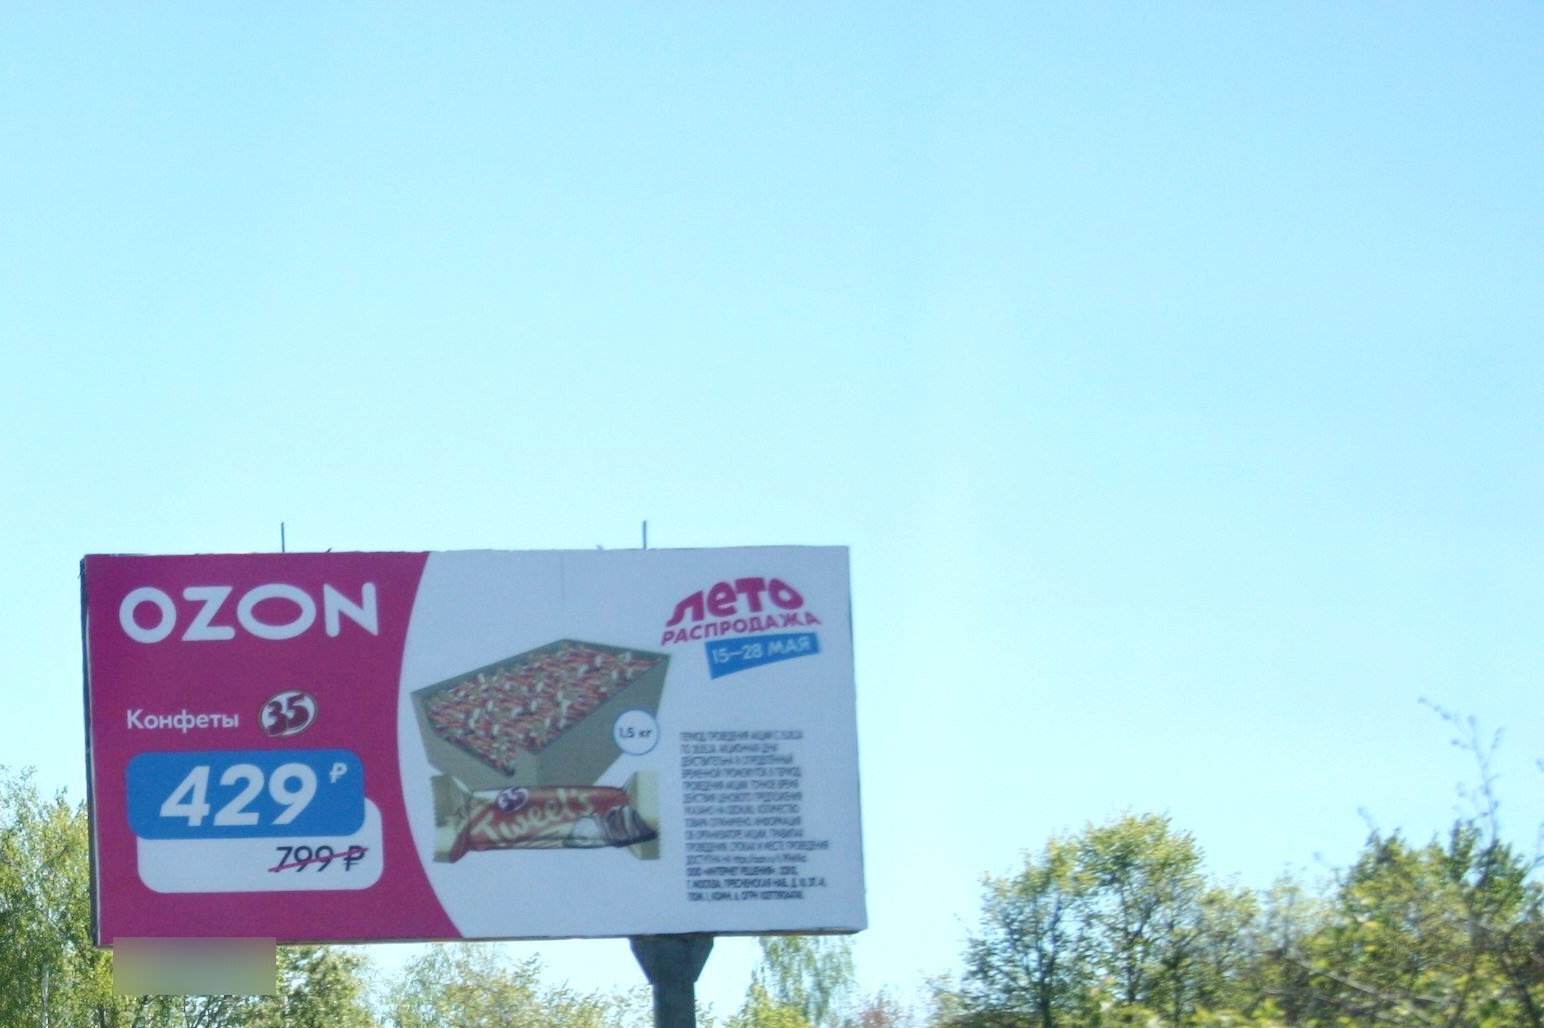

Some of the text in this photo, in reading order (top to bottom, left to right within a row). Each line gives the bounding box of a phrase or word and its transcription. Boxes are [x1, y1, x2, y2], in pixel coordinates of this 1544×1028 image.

[119, 582, 379, 643] OZON
[660, 612, 822, 646] РАСПРОДАЖА
[768, 636, 811, 656] МАЯ
[126, 692, 312, 736] Конфеты 35
[159, 762, 318, 827] 429
[275, 845, 334, 873] 799
